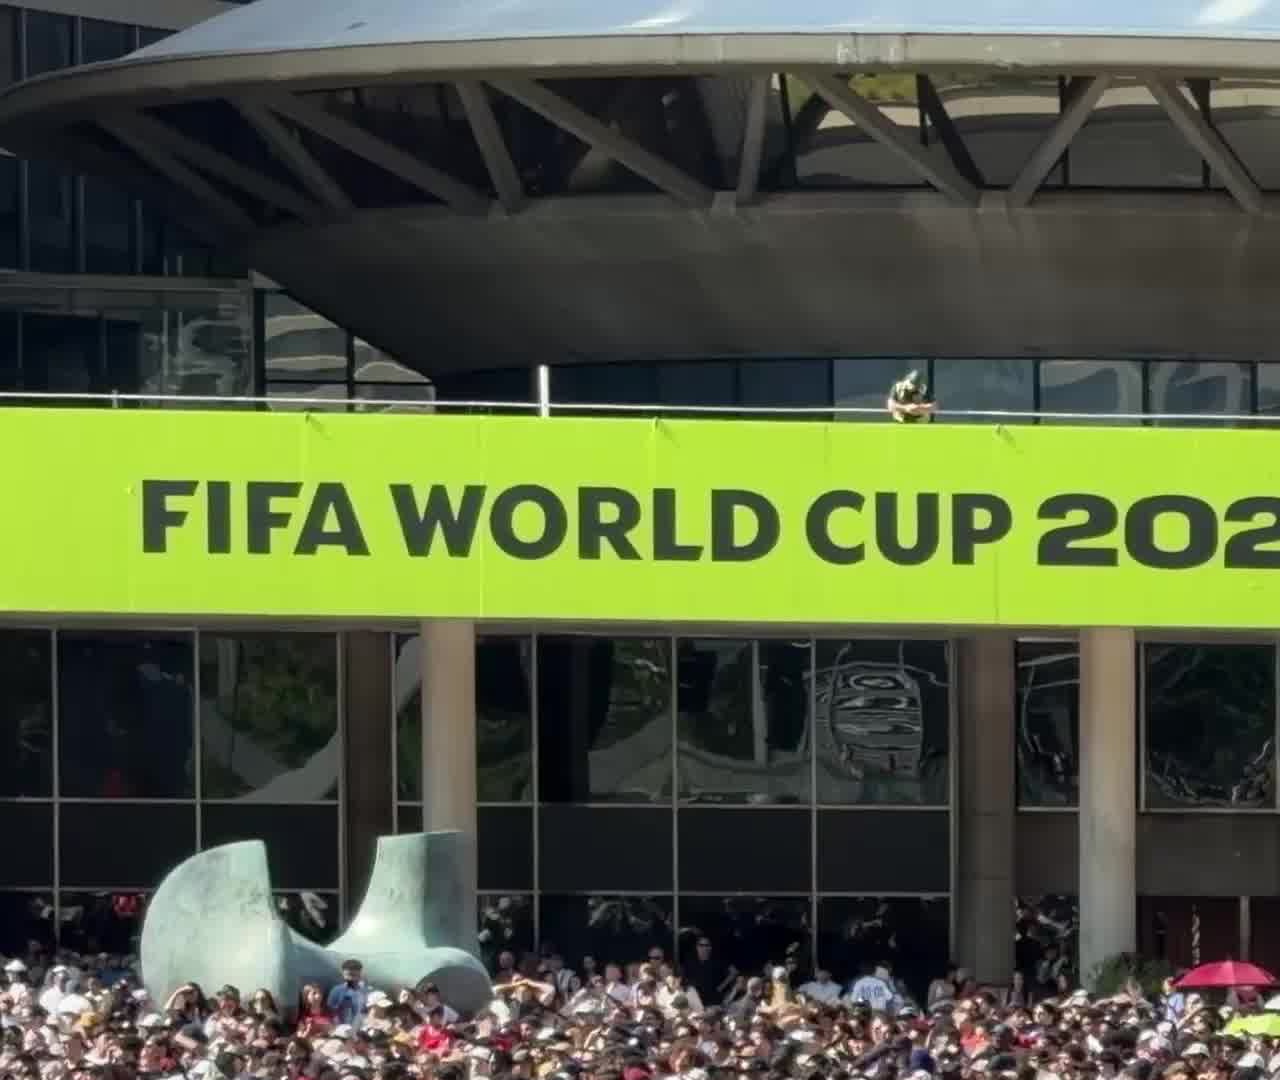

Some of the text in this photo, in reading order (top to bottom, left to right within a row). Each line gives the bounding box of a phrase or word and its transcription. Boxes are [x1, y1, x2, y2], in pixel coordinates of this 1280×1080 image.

[143, 480, 370, 556] FIFA
[390, 484, 780, 562] WORLD
[805, 489, 1012, 566] CUP
